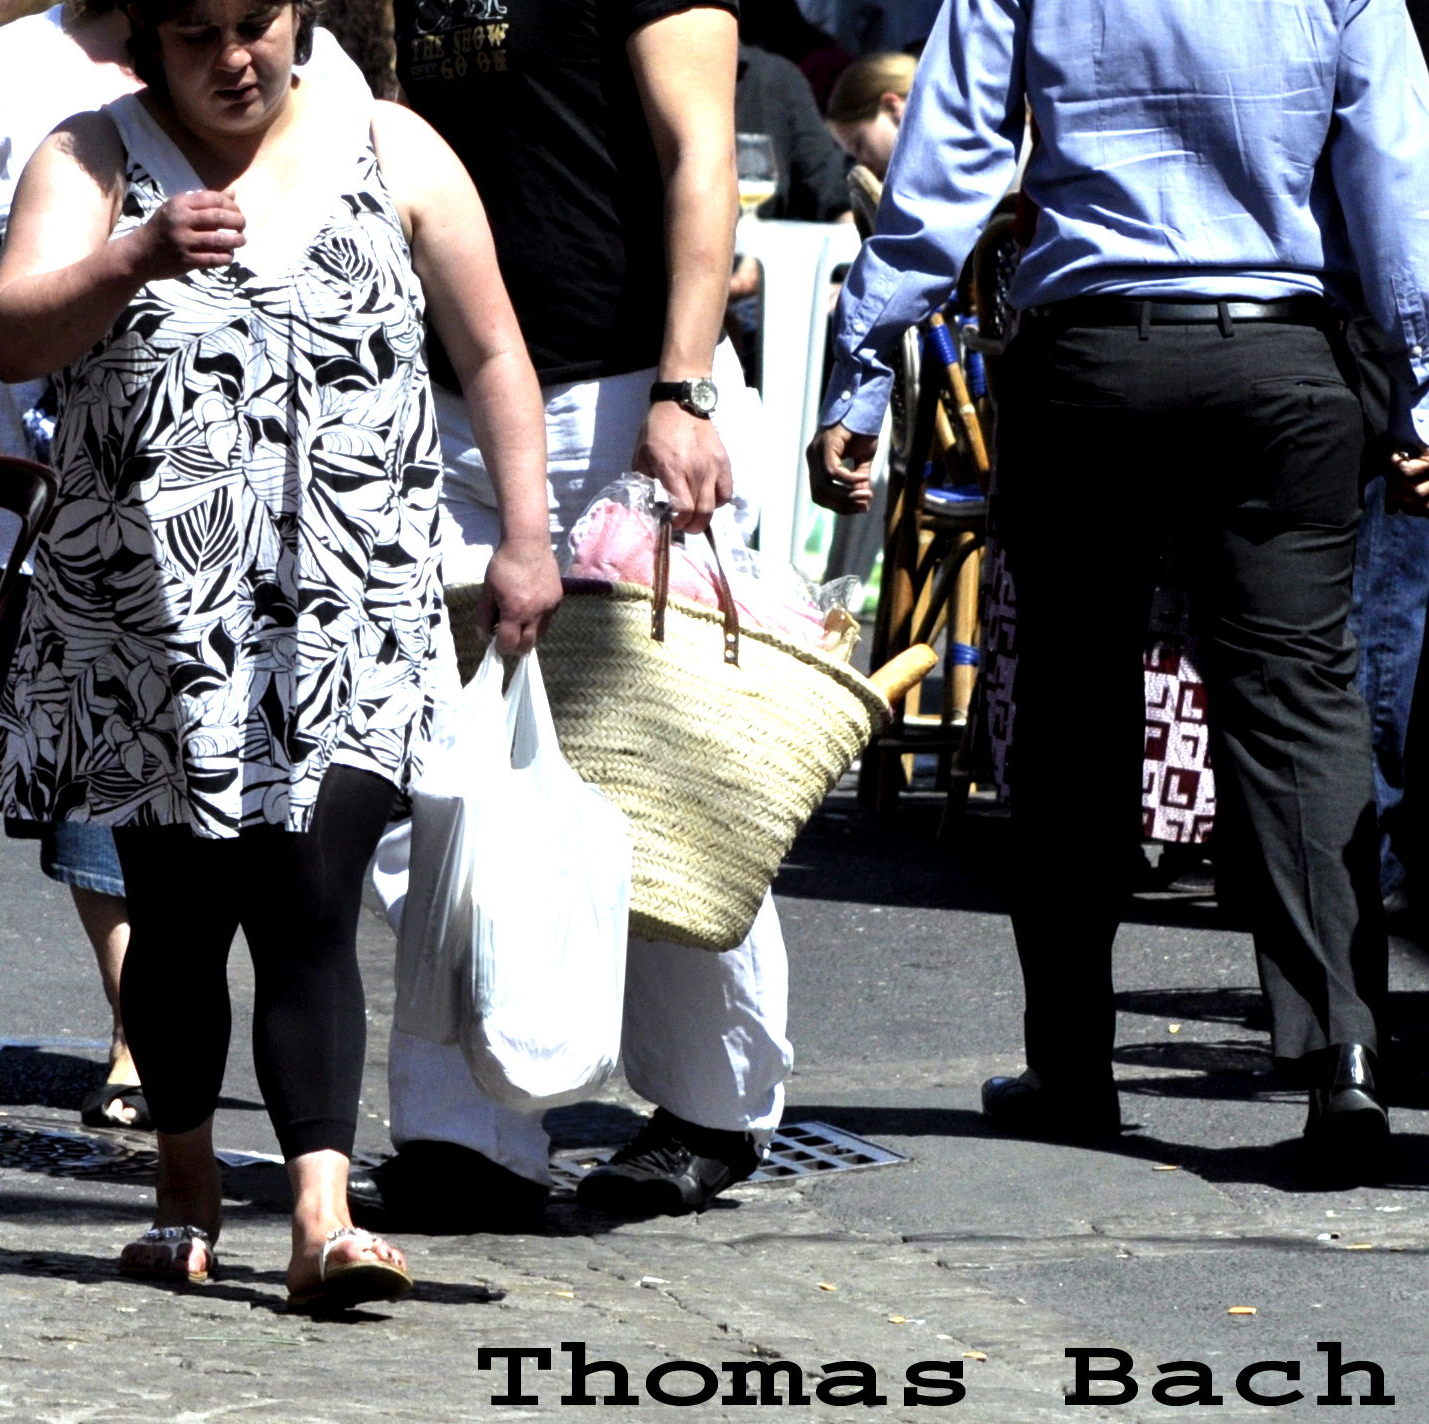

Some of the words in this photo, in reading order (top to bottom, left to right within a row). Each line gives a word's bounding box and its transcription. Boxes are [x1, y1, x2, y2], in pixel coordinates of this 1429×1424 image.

[410, 34, 445, 63] THE
[452, 22, 510, 57] SHOW
[440, 54, 469, 80] GO
